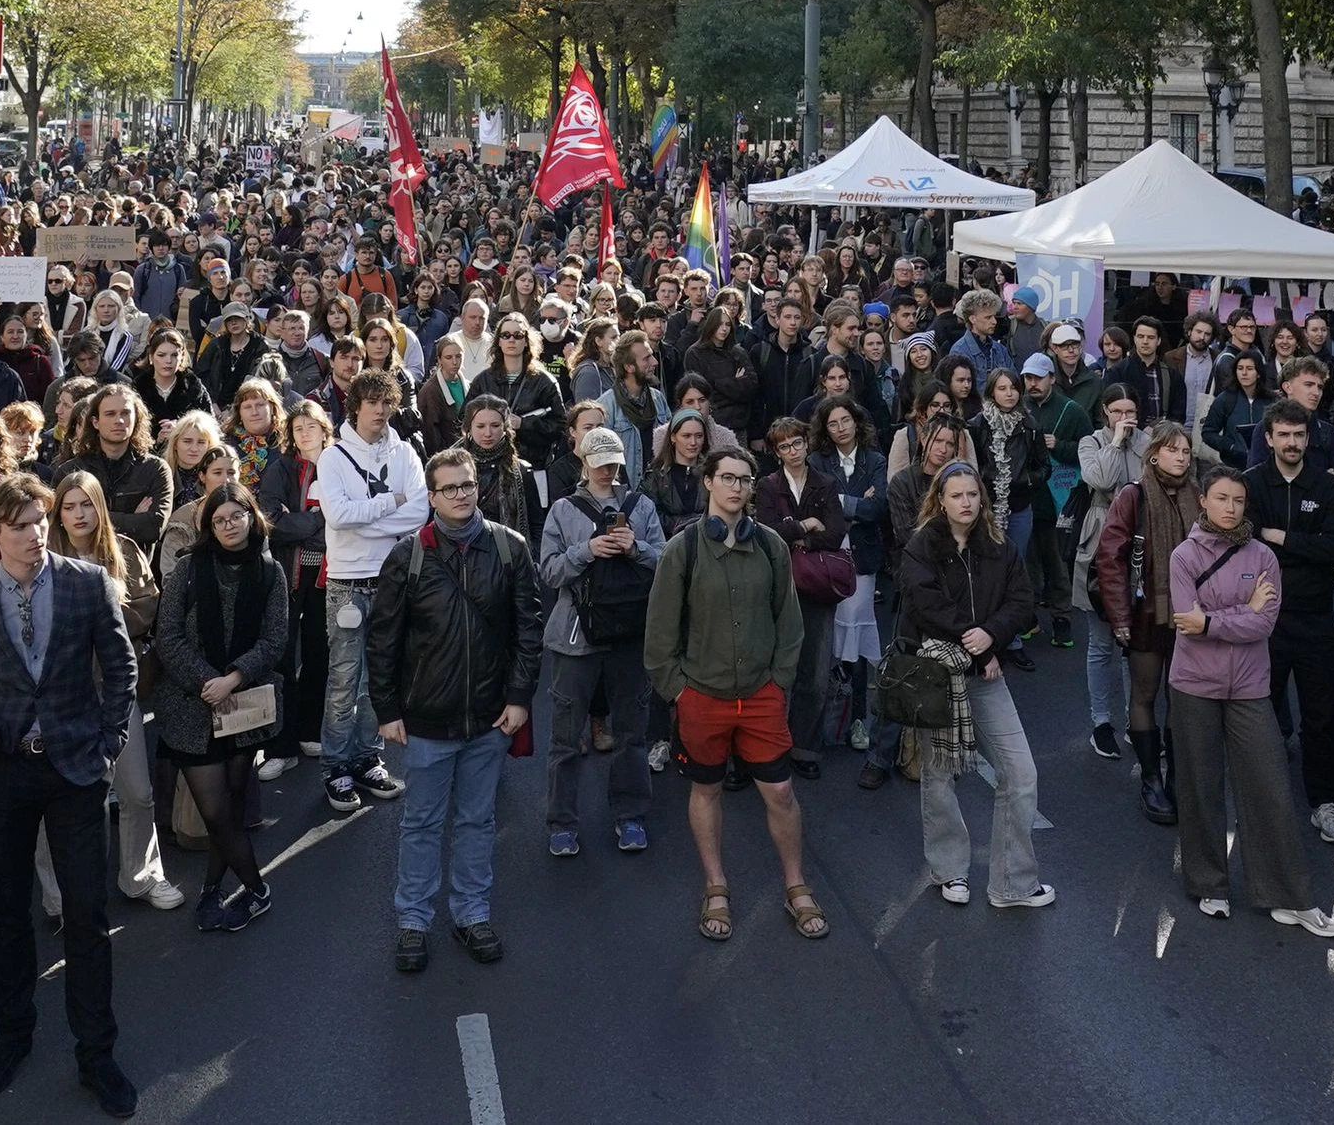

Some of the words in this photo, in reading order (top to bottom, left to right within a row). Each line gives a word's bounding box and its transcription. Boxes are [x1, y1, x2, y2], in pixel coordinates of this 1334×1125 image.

[248, 147, 263, 160] NO
[887, 194, 899, 203] die
[980, 195, 994, 205] das
